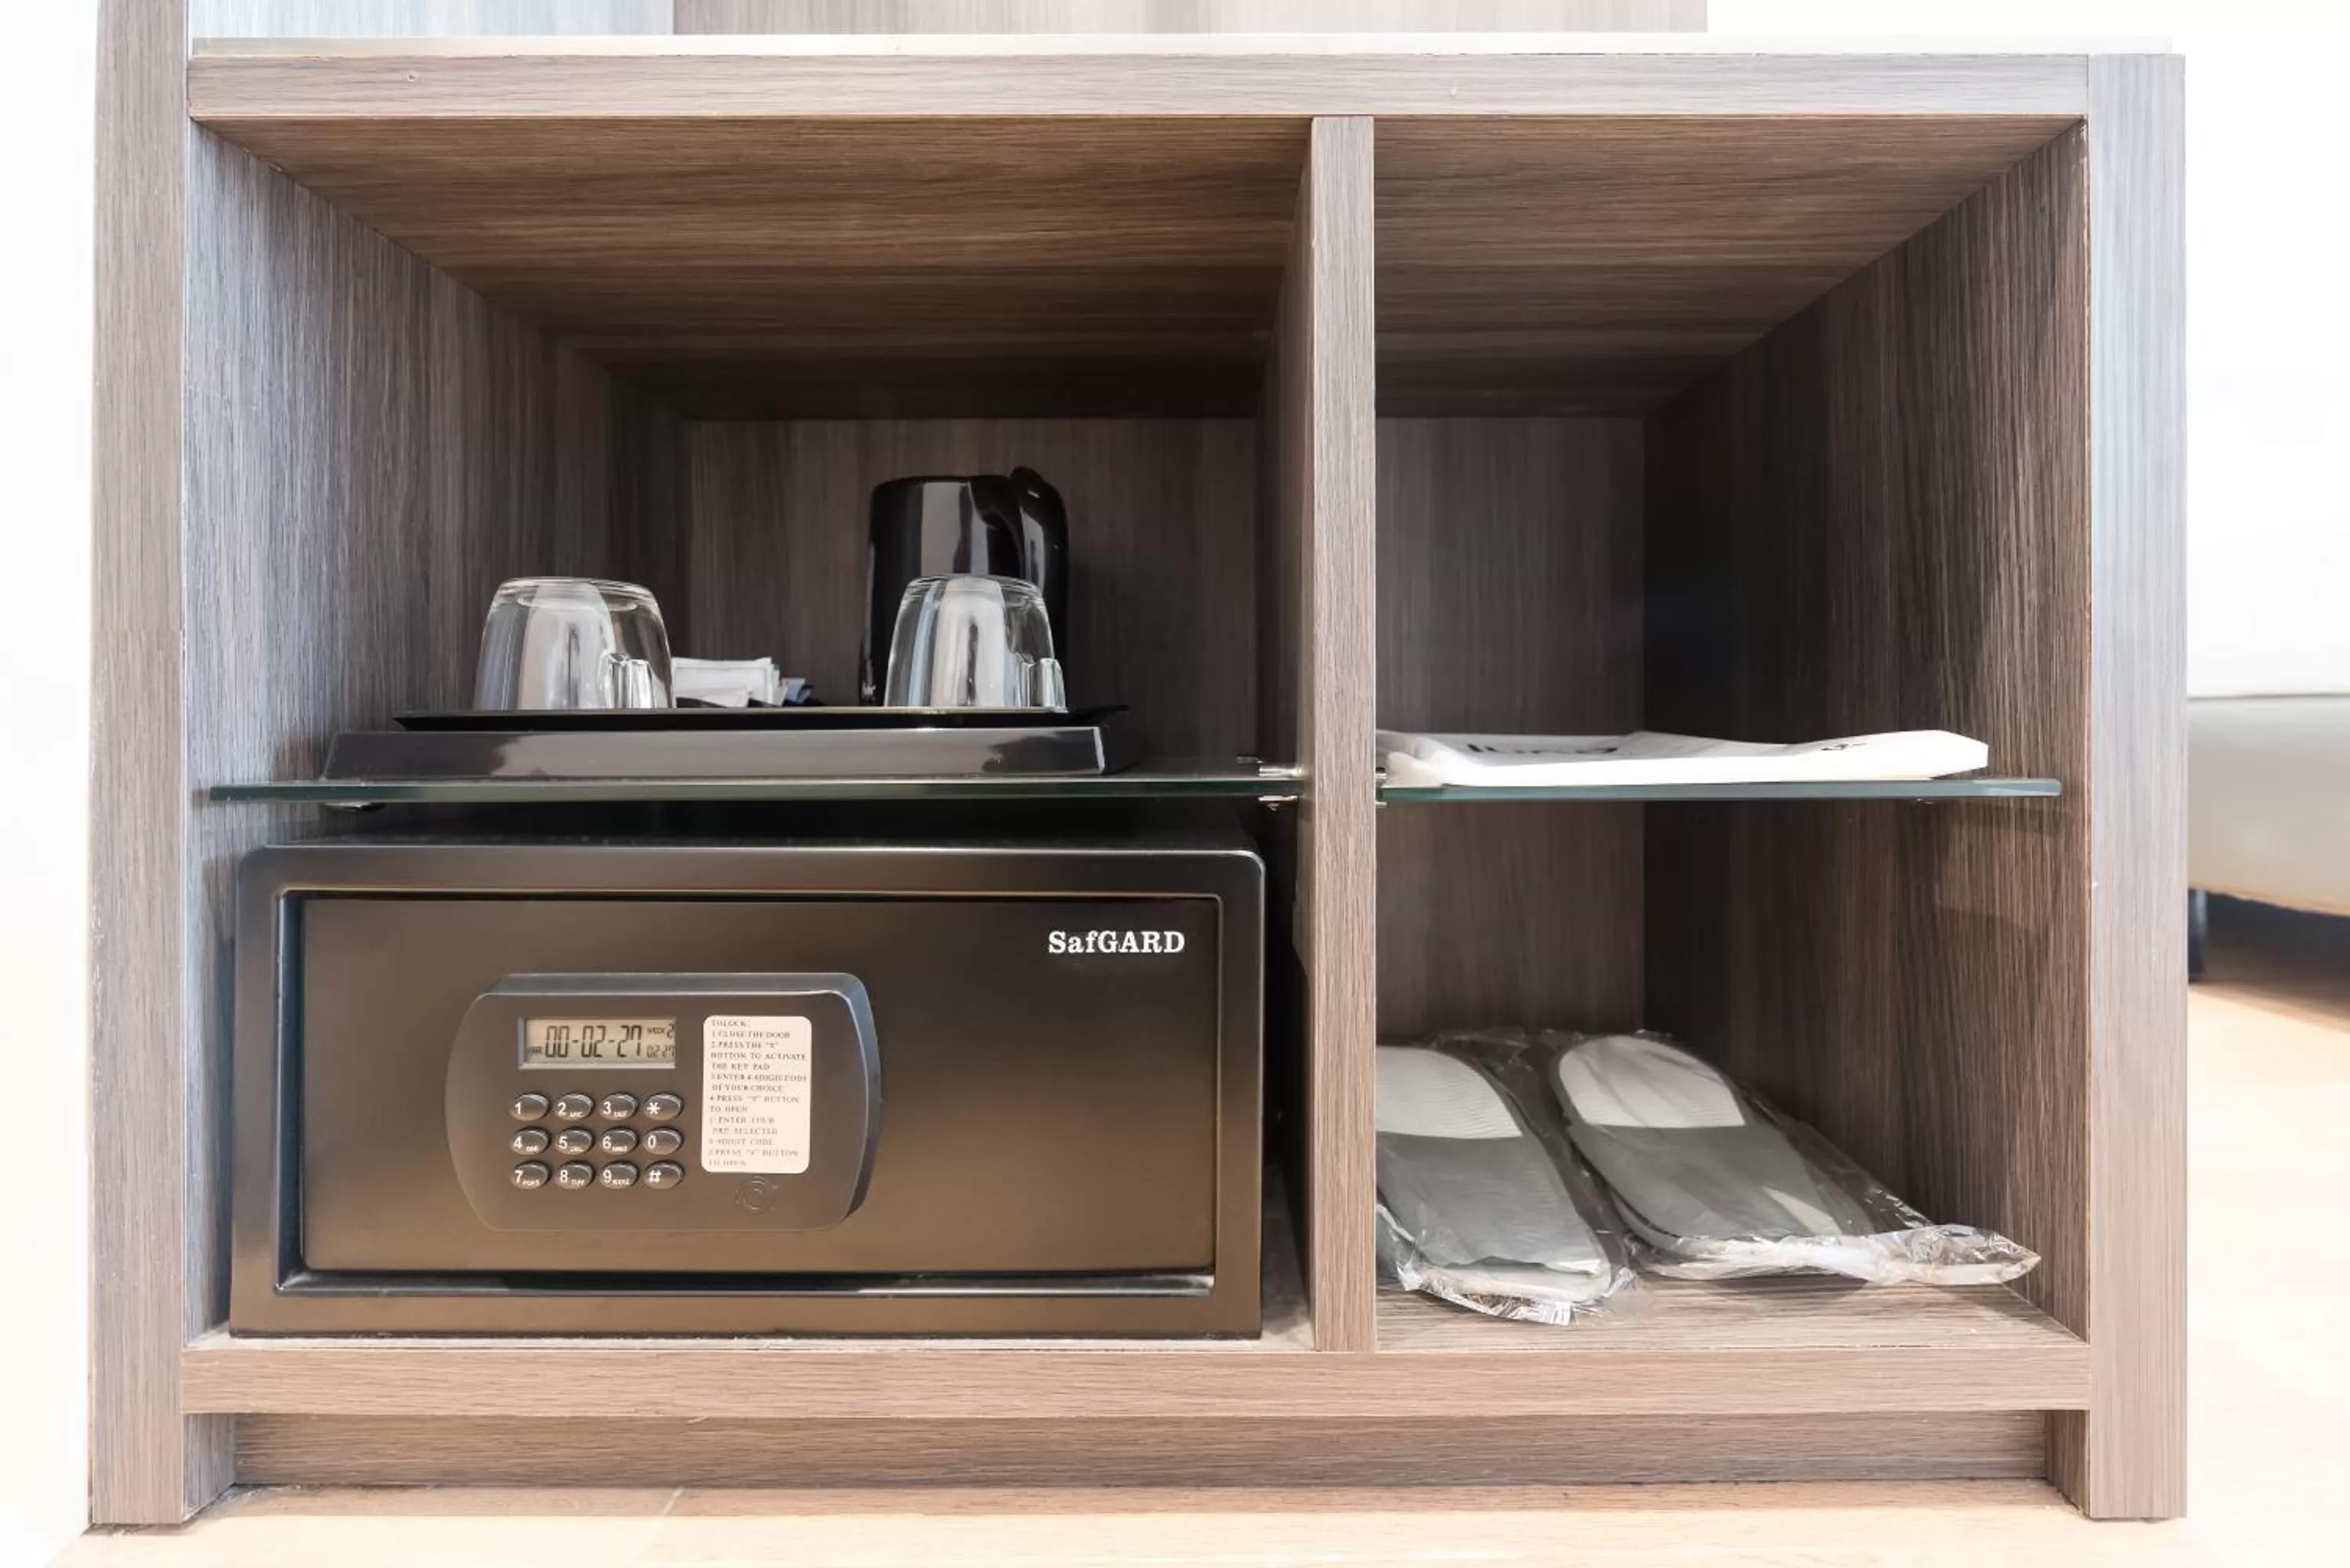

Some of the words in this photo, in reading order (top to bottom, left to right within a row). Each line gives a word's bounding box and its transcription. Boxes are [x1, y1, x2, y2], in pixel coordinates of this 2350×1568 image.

[1049, 930, 1185, 953] SafGARD
[514, 1102, 522, 1115] 1
[557, 1102, 566, 1116] 2
[602, 1101, 612, 1115] 3
[513, 1136, 522, 1150] 4
[559, 1136, 568, 1149] 5
[602, 1136, 612, 1149] 6
[647, 1135, 656, 1149] 0
[514, 1169, 524, 1183] 7
[560, 1169, 569, 1183] 8
[602, 1169, 612, 1183] 9
